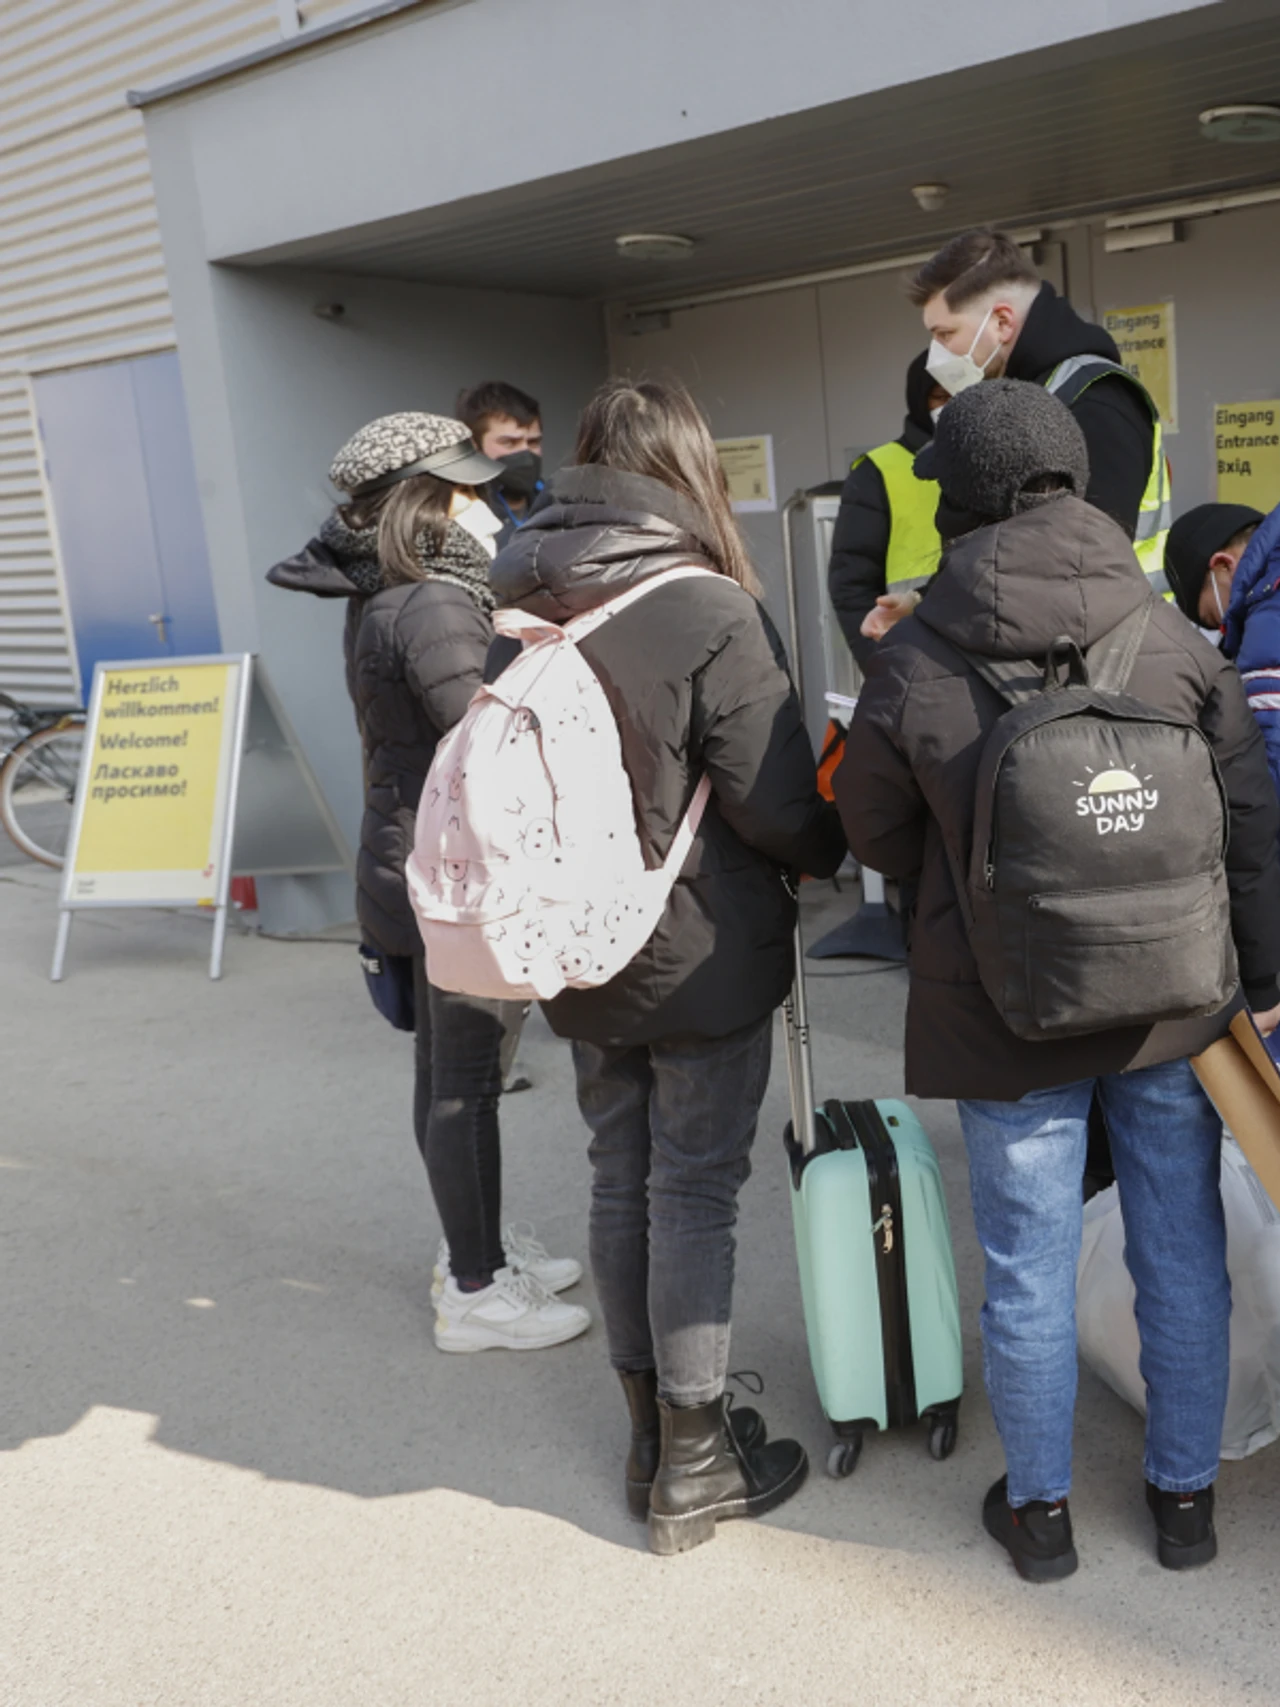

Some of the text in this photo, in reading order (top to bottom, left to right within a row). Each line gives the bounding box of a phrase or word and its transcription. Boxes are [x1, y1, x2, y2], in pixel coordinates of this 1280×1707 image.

[1106, 313, 1160, 332] Eingang
[1118, 337, 1165, 352] ntrance
[1216, 409, 1275, 428] Eingang
[1216, 433, 1279, 449] Entrance
[107, 675, 180, 695] Herzlich
[103, 696, 220, 718] willkommen!
[100, 729, 188, 749] Welcome!
[94, 763, 179, 780] Ласкаво
[91, 779, 188, 803] просимо!
[1076, 789, 1158, 816] SUNNY
[1096, 812, 1145, 835] DAY
